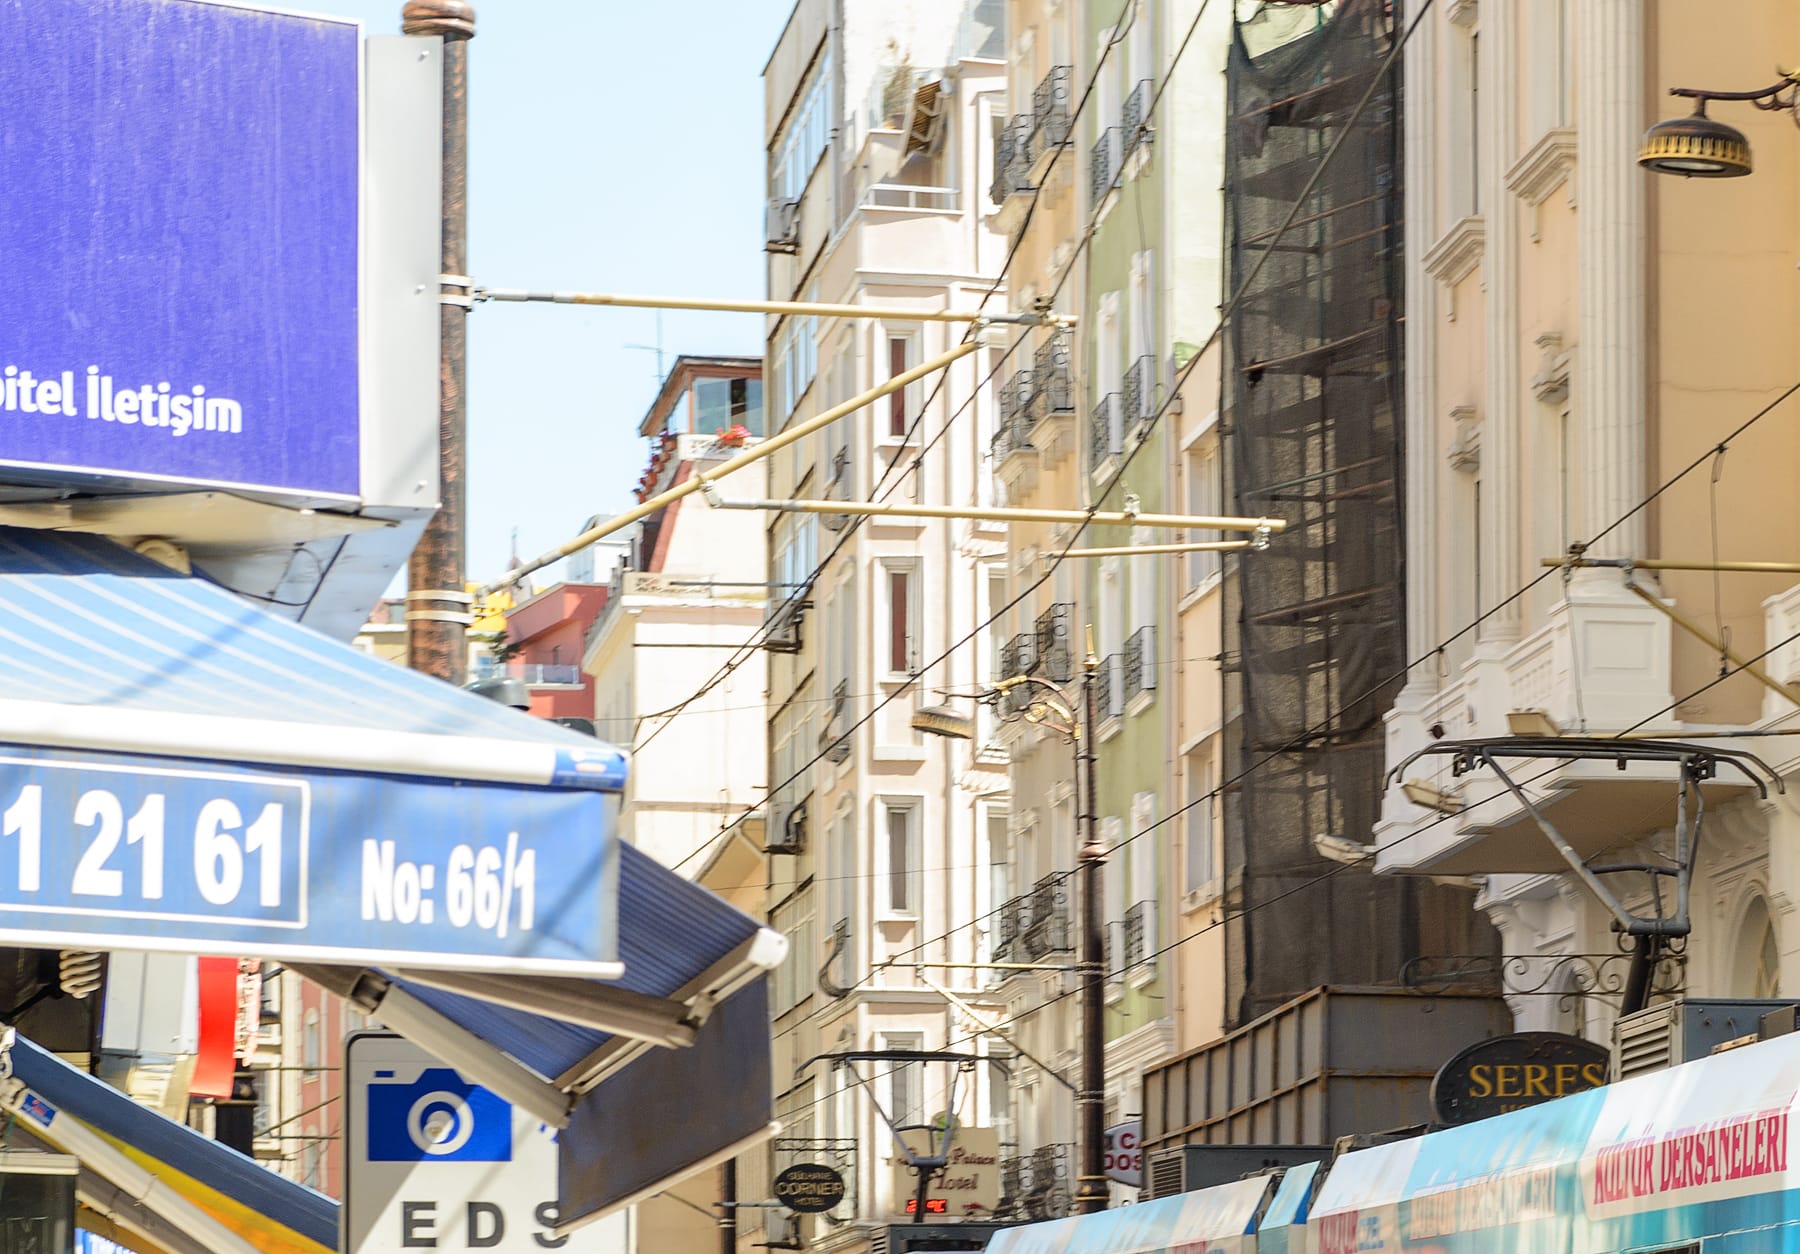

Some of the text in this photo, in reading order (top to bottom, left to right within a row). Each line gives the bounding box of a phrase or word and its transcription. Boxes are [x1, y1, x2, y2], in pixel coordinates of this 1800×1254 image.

[0, 364, 243, 437] itel İletişim
[72, 790, 165, 899] 21
[194, 798, 284, 907] 61
[361, 831, 536, 939] No: 66/1
[1468, 1063, 1606, 1097] SERES
